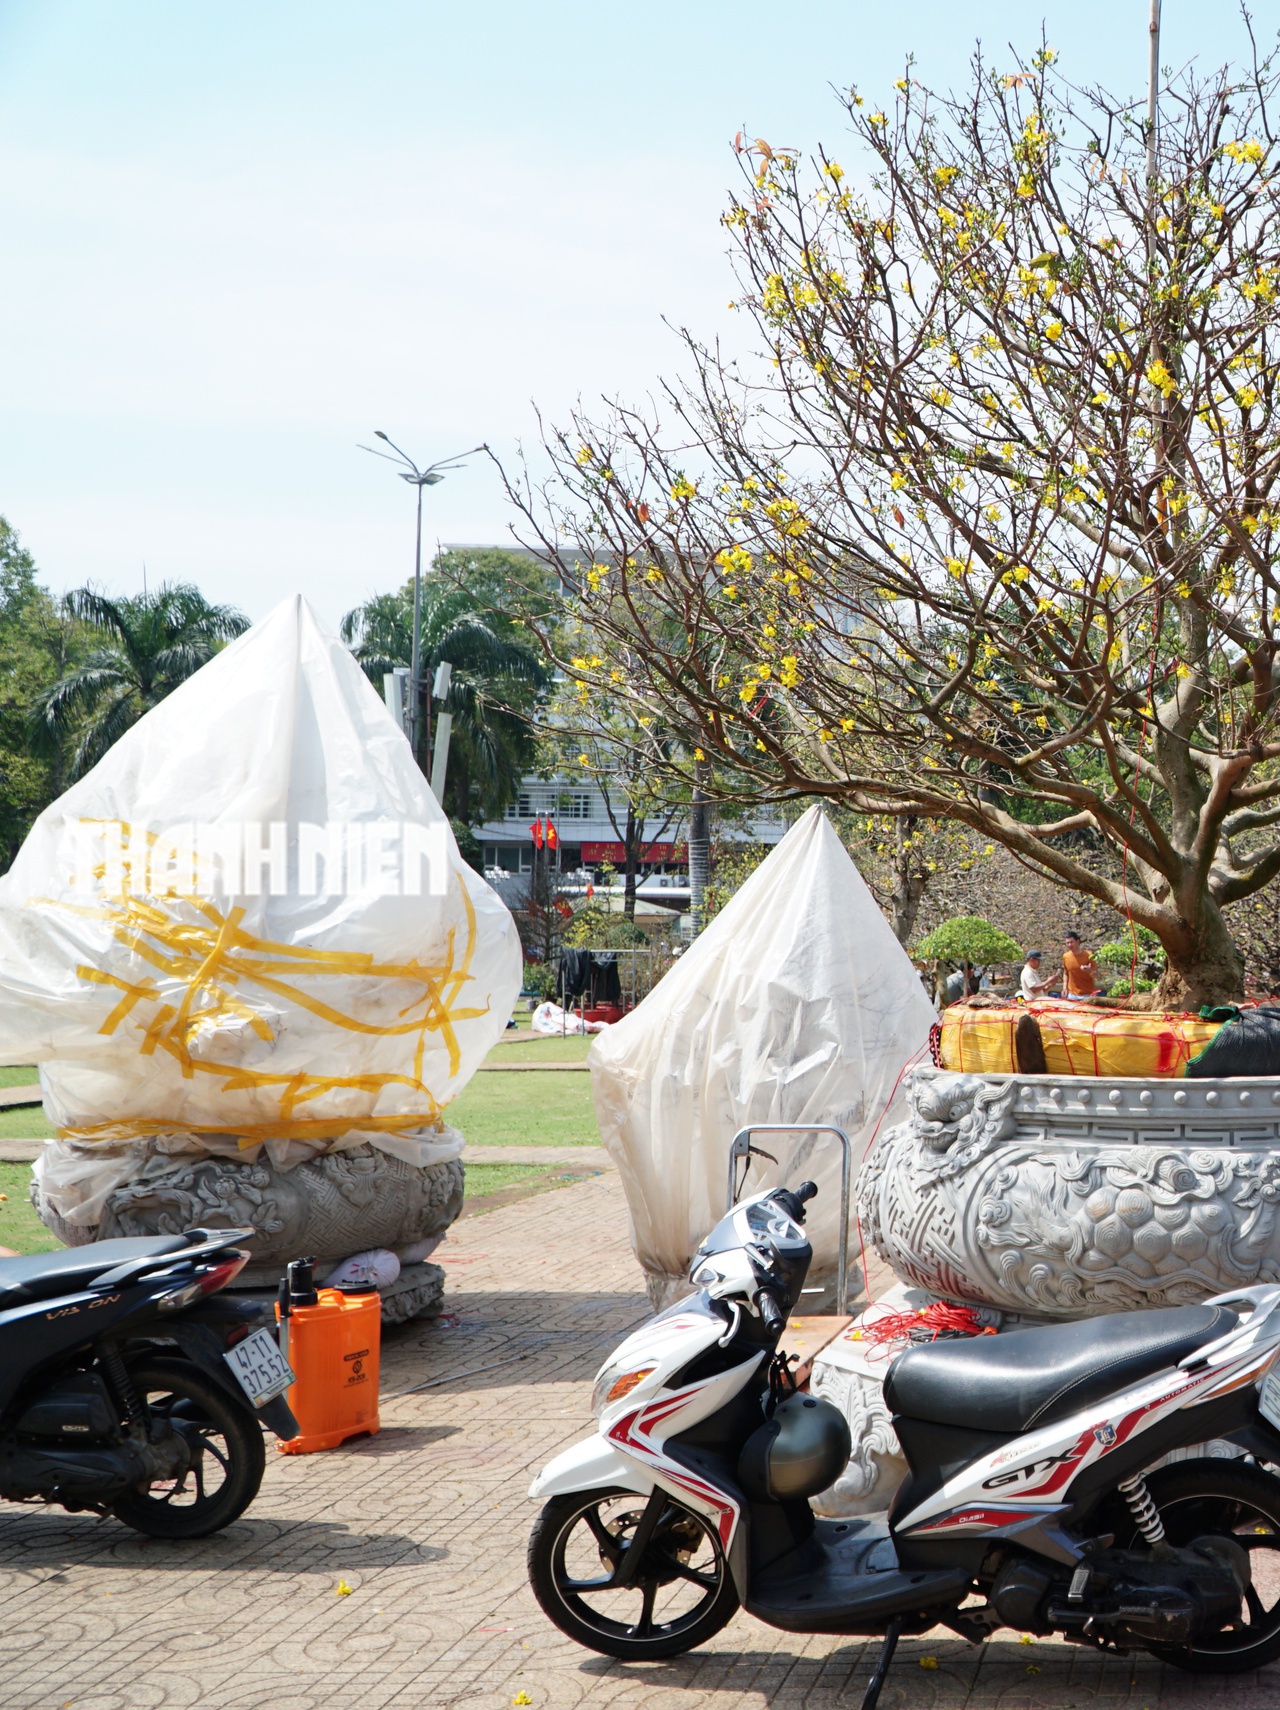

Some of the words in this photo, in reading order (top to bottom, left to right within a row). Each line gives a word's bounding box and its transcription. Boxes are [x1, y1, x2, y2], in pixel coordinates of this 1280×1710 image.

[243, 1354, 289, 1394] 375.52
[1159, 1376, 1206, 1402] AUTOMATIC
[982, 1446, 1079, 1489] GTX
